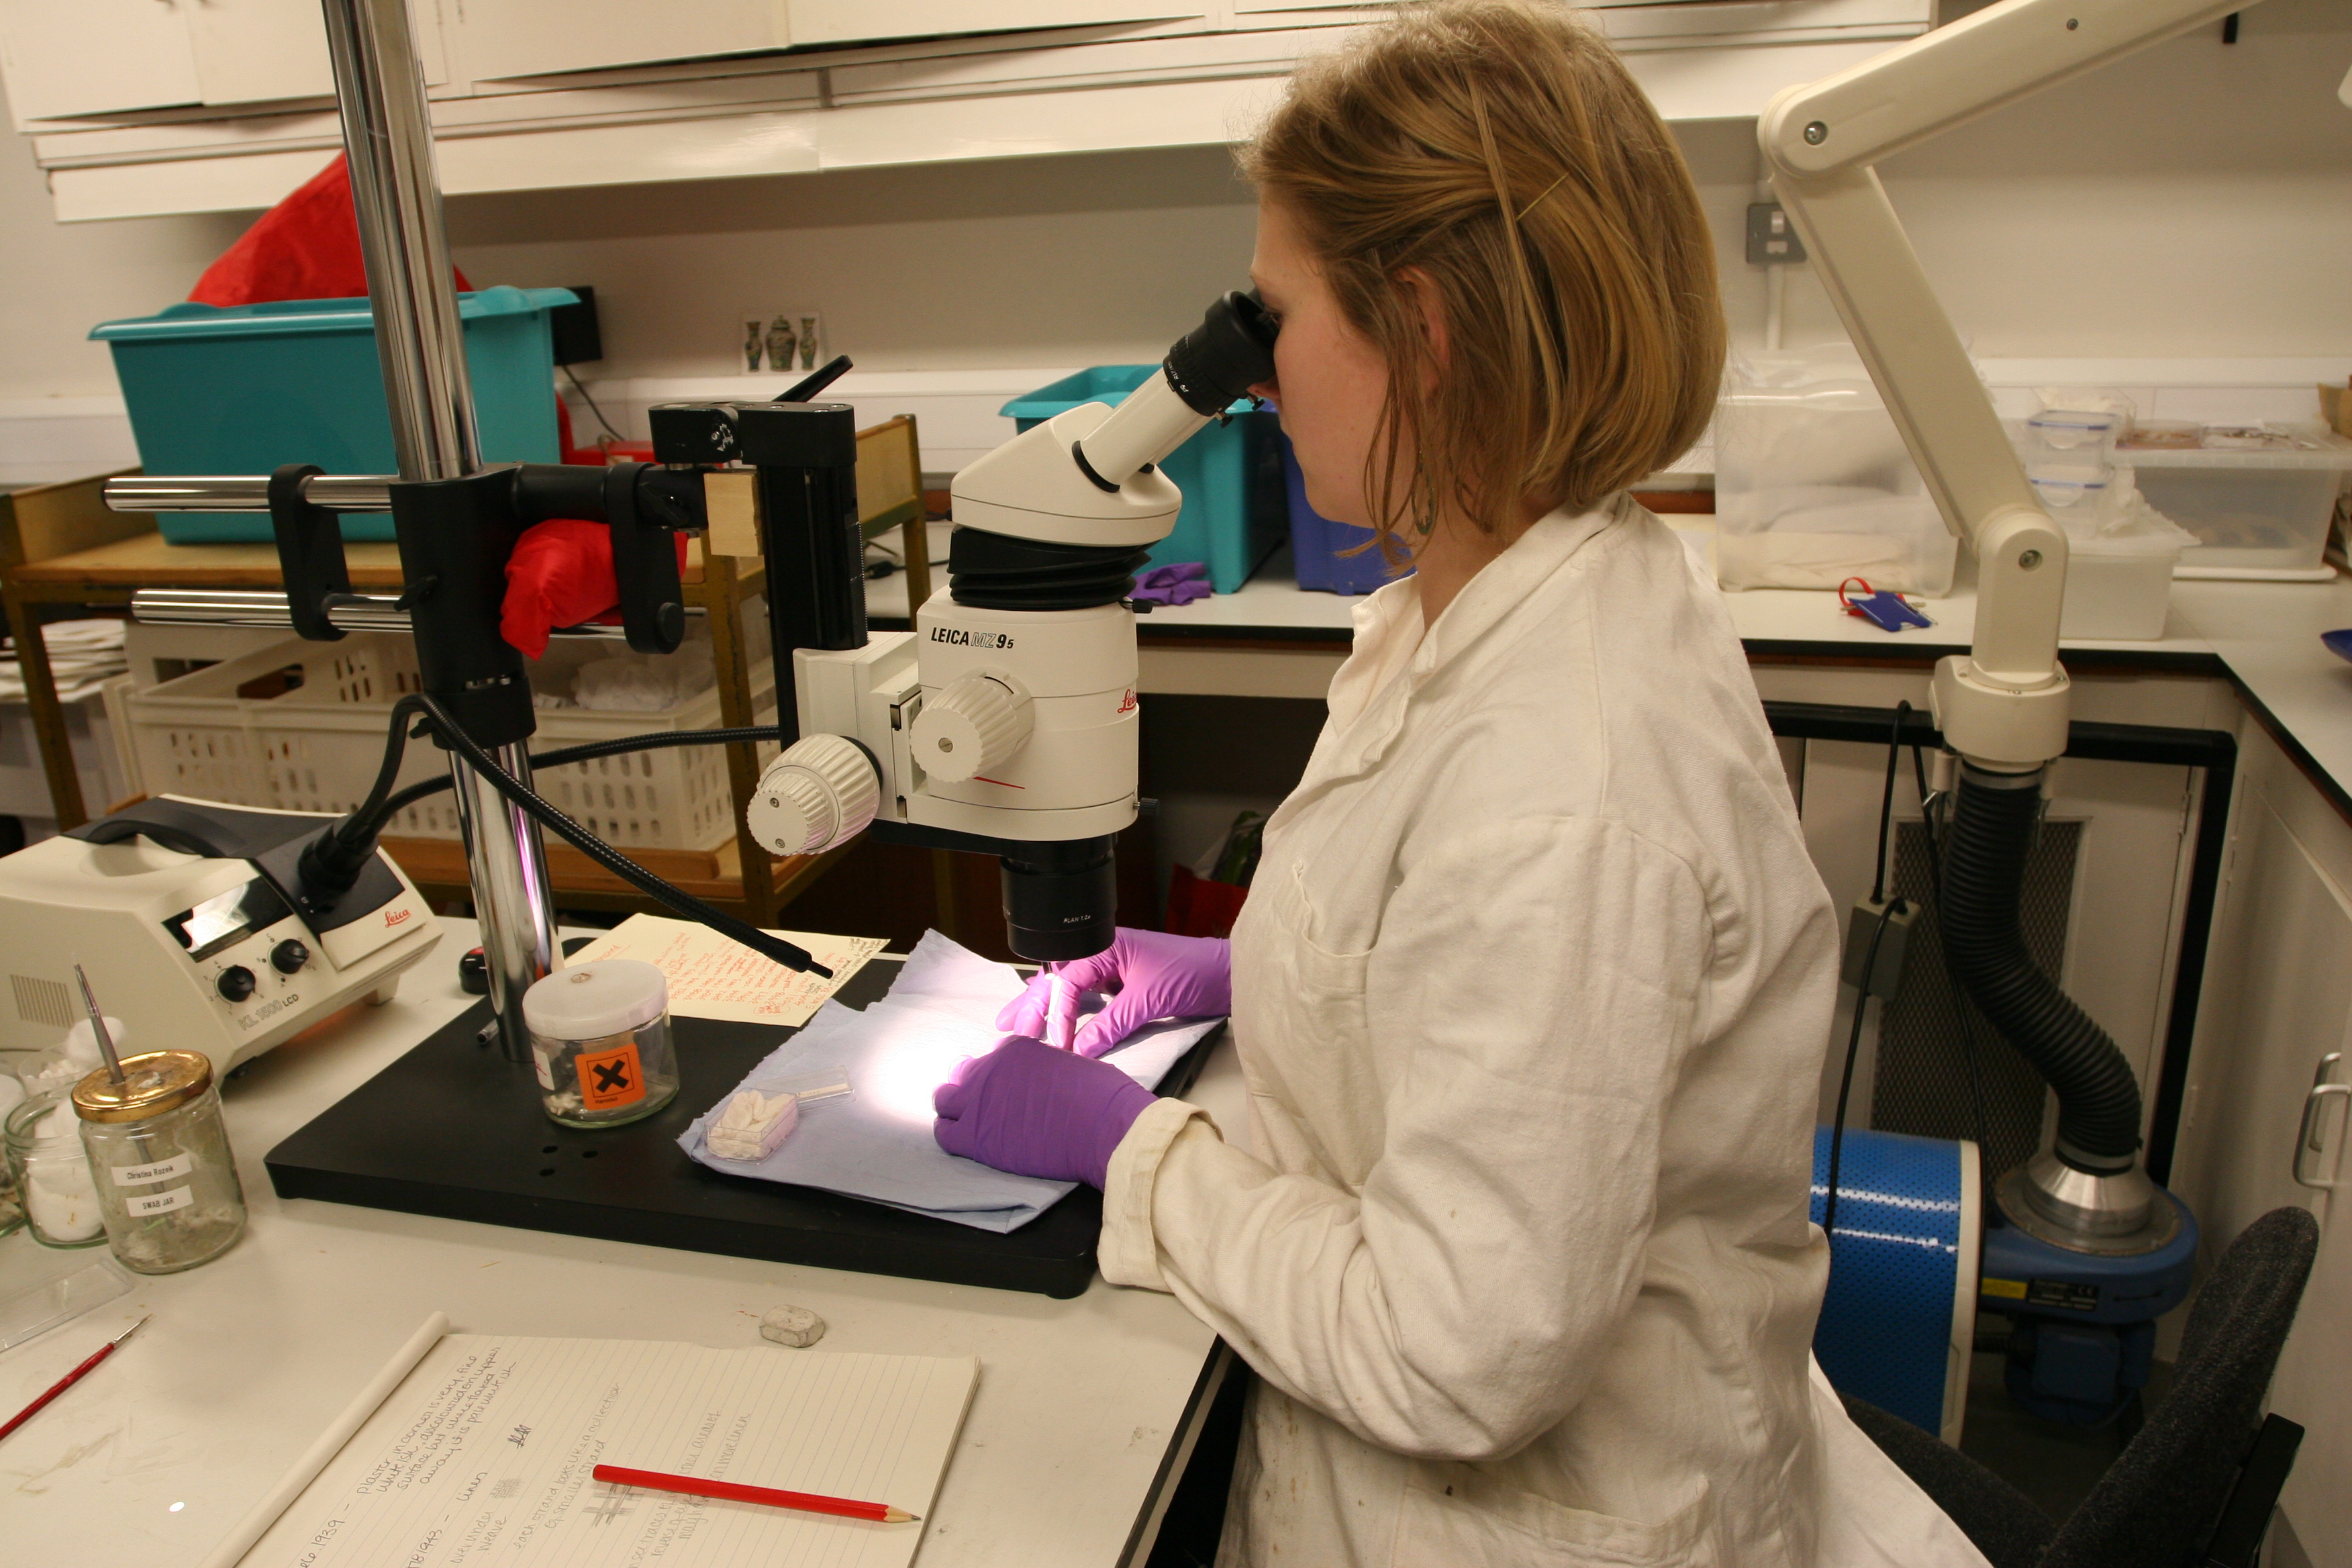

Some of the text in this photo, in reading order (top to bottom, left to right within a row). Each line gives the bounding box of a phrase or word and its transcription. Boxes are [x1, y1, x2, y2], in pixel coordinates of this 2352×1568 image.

[931, 628, 969, 645] LEICA
[385, 909, 411, 928] Leica
[238, 1015, 259, 1030] KL
[255, 999, 283, 1020] 1500
[282, 993, 299, 1008] LCD
[126, 1169, 152, 1180] Christina
[142, 1197, 175, 1210] SWAB JAR
[475, 1348, 500, 1375] upper
[397, 1453, 433, 1490] surface
[426, 1434, 446, 1450] but
[446, 1403, 473, 1429] where
[420, 1449, 462, 1483] away
[467, 1406, 485, 1423] pale
[532, 1487, 559, 1520] strand
[589, 1383, 620, 1432] collection
[356, 1458, 391, 1494] plaster
